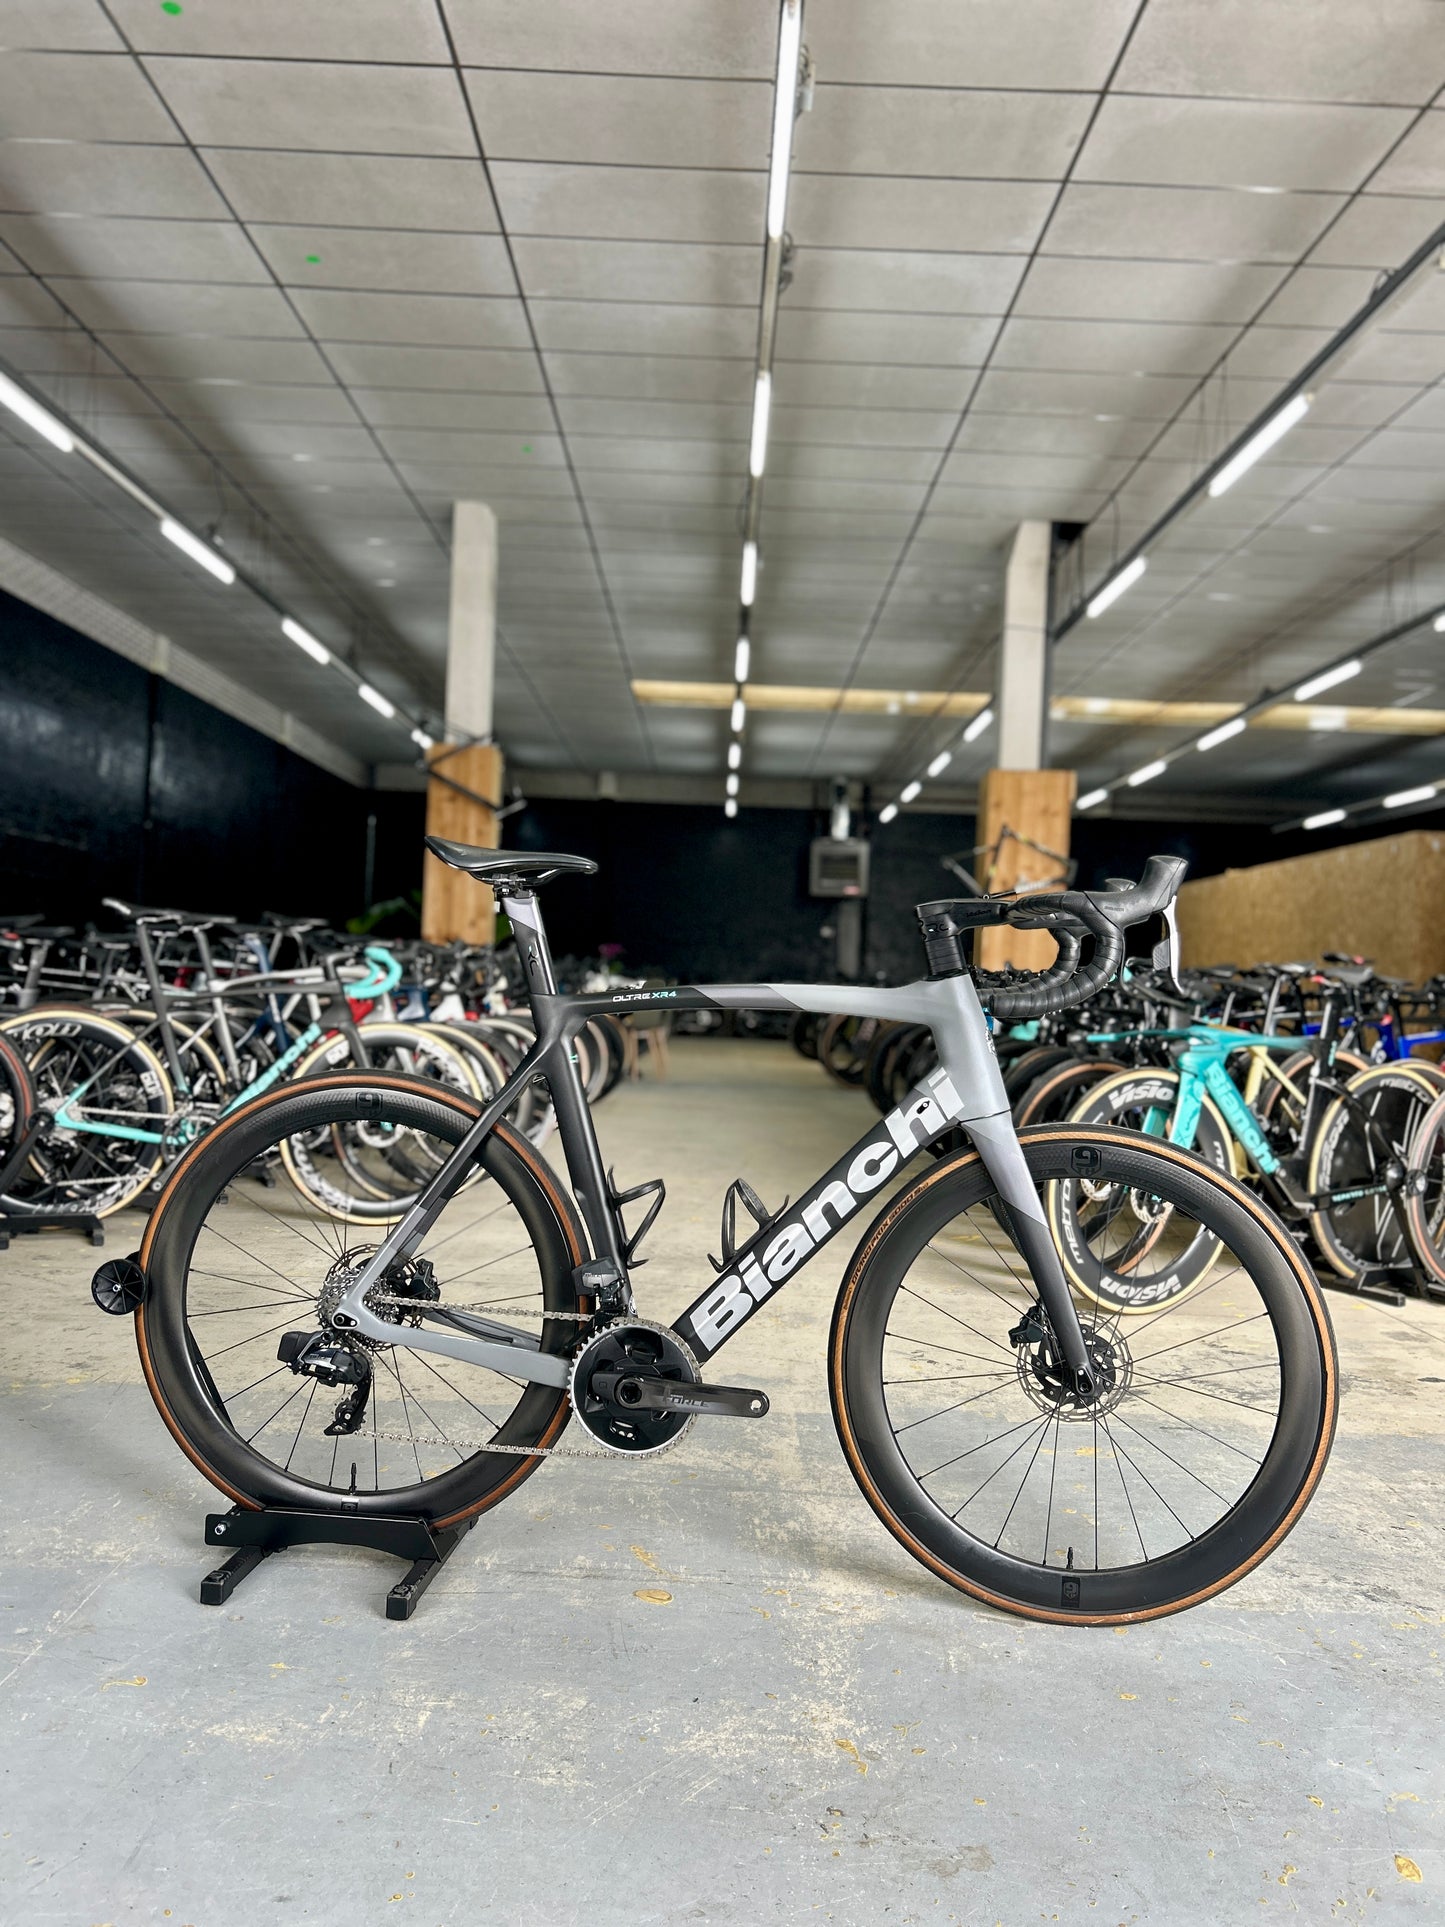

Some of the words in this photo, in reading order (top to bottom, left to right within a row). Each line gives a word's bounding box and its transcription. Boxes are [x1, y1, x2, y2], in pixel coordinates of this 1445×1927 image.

[612, 992, 651, 1003] OLTRE
[652, 990, 677, 999] XR4
[1108, 1080, 1175, 1110] Visio
[1204, 1060, 1281, 1175] Bianchi
[689, 1067, 965, 1352] Bianchi
[850, 1245, 872, 1285] GRAND
[871, 1222, 890, 1246] PRIX
[888, 1194, 914, 1223] 5000
[1062, 1178, 1084, 1265] metro
